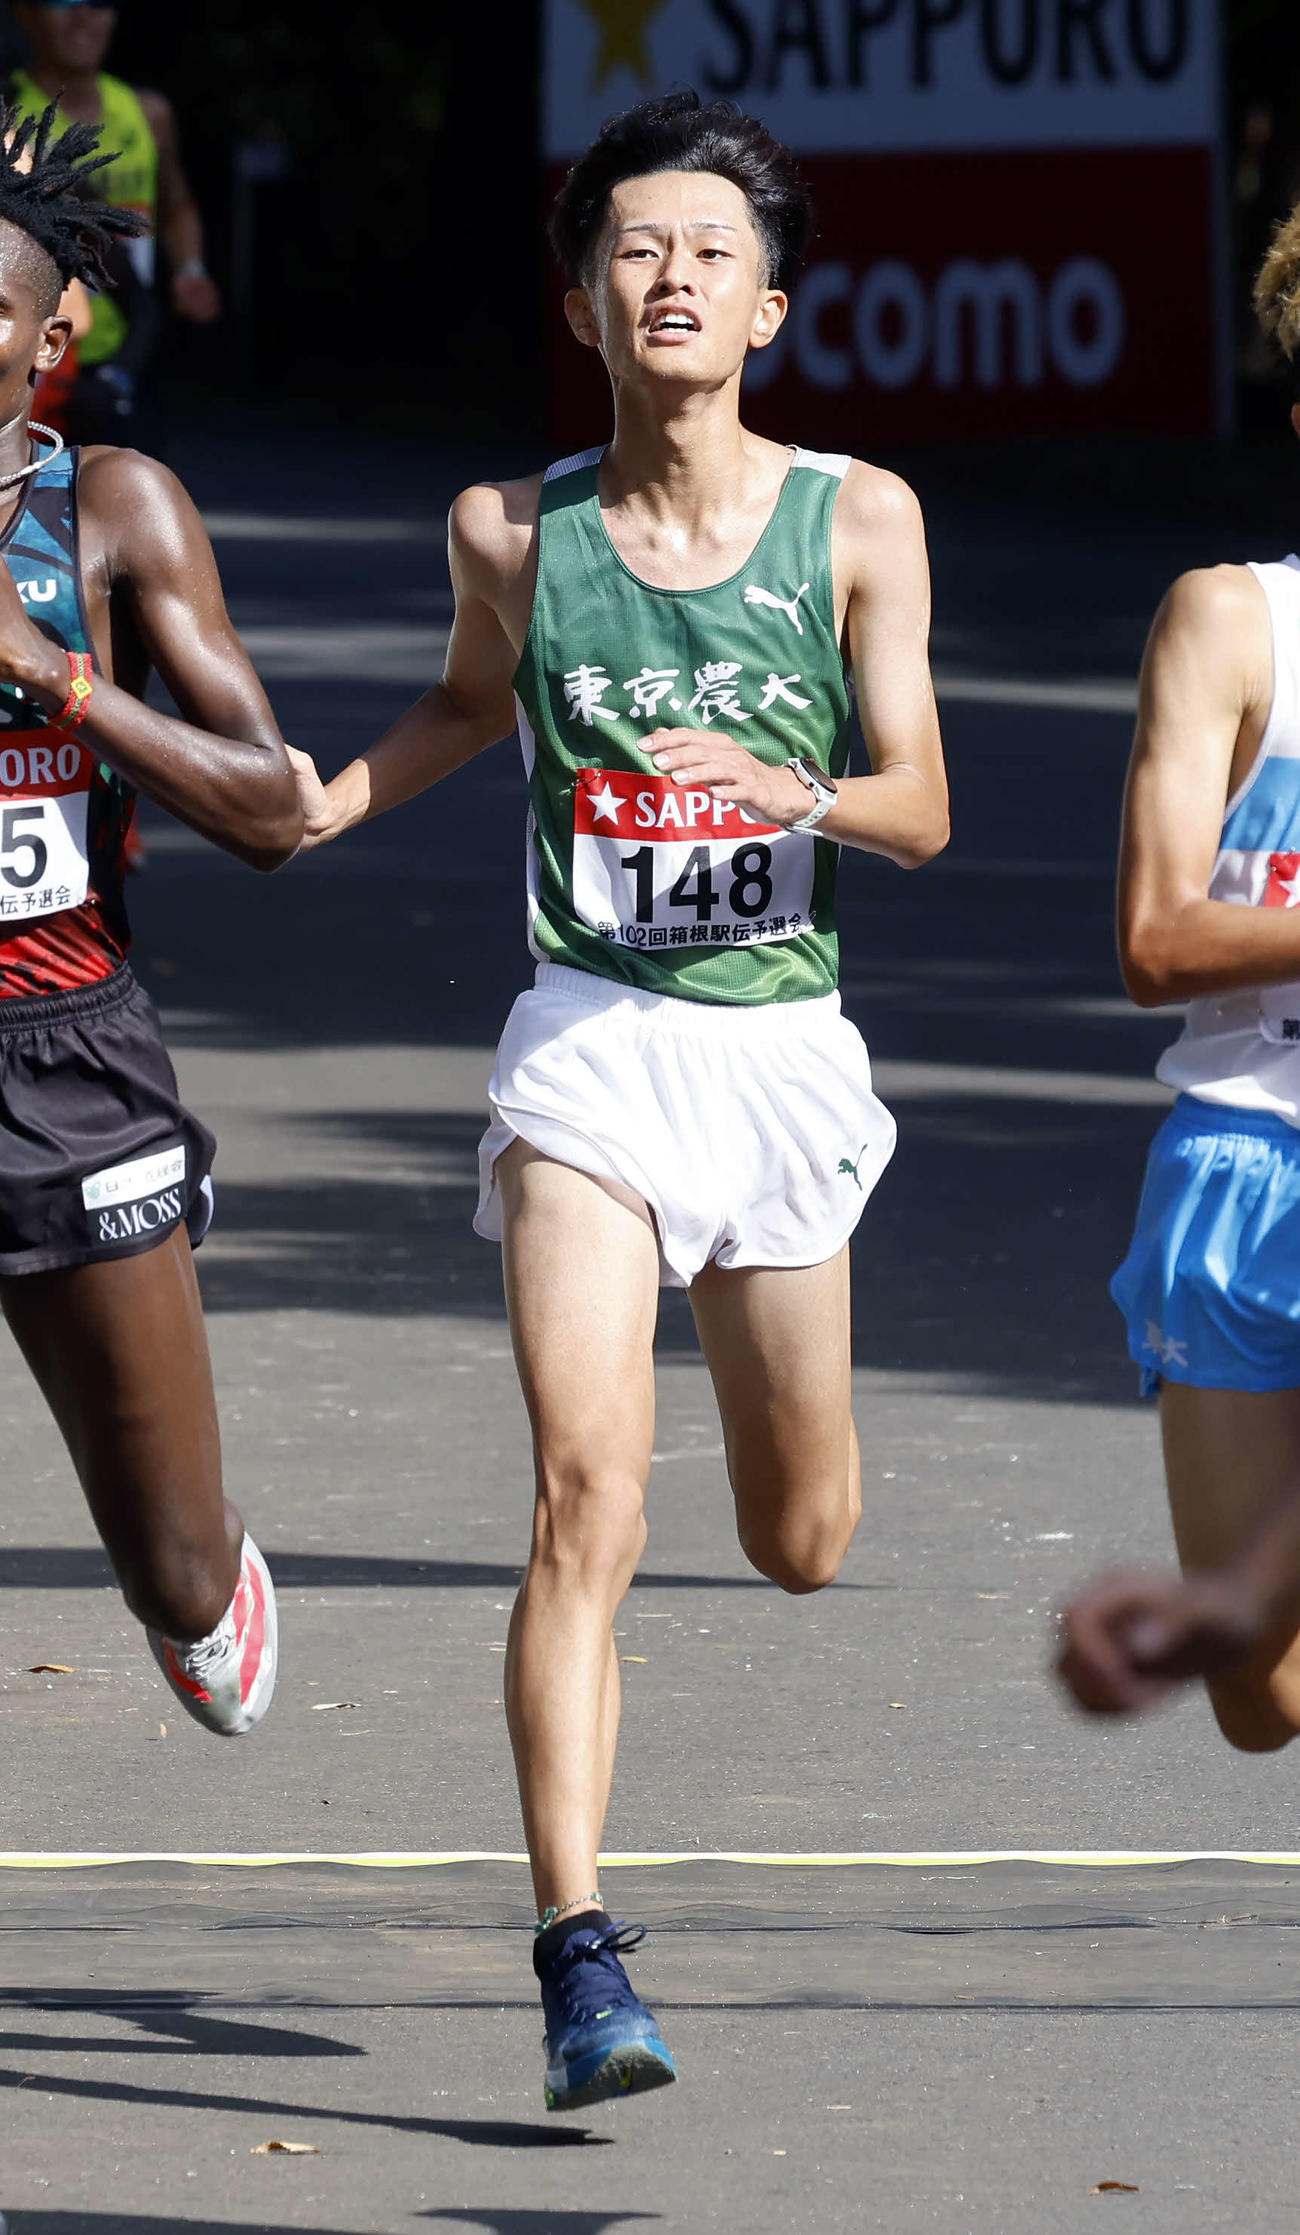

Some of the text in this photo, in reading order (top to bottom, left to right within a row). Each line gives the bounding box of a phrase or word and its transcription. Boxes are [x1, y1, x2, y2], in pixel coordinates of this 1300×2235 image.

[701, 0, 1189, 93] SAPPORO
[741, 255, 1126, 391] como
[563, 661, 813, 726] 東京農大
[0, 744, 81, 787] ORO
[1, 805, 48, 888] 5
[621, 841, 773, 924] 148
[598, 912, 802, 947] 第102回箱根駅伝予選会
[99, 1188, 182, 1242] &MOSS
